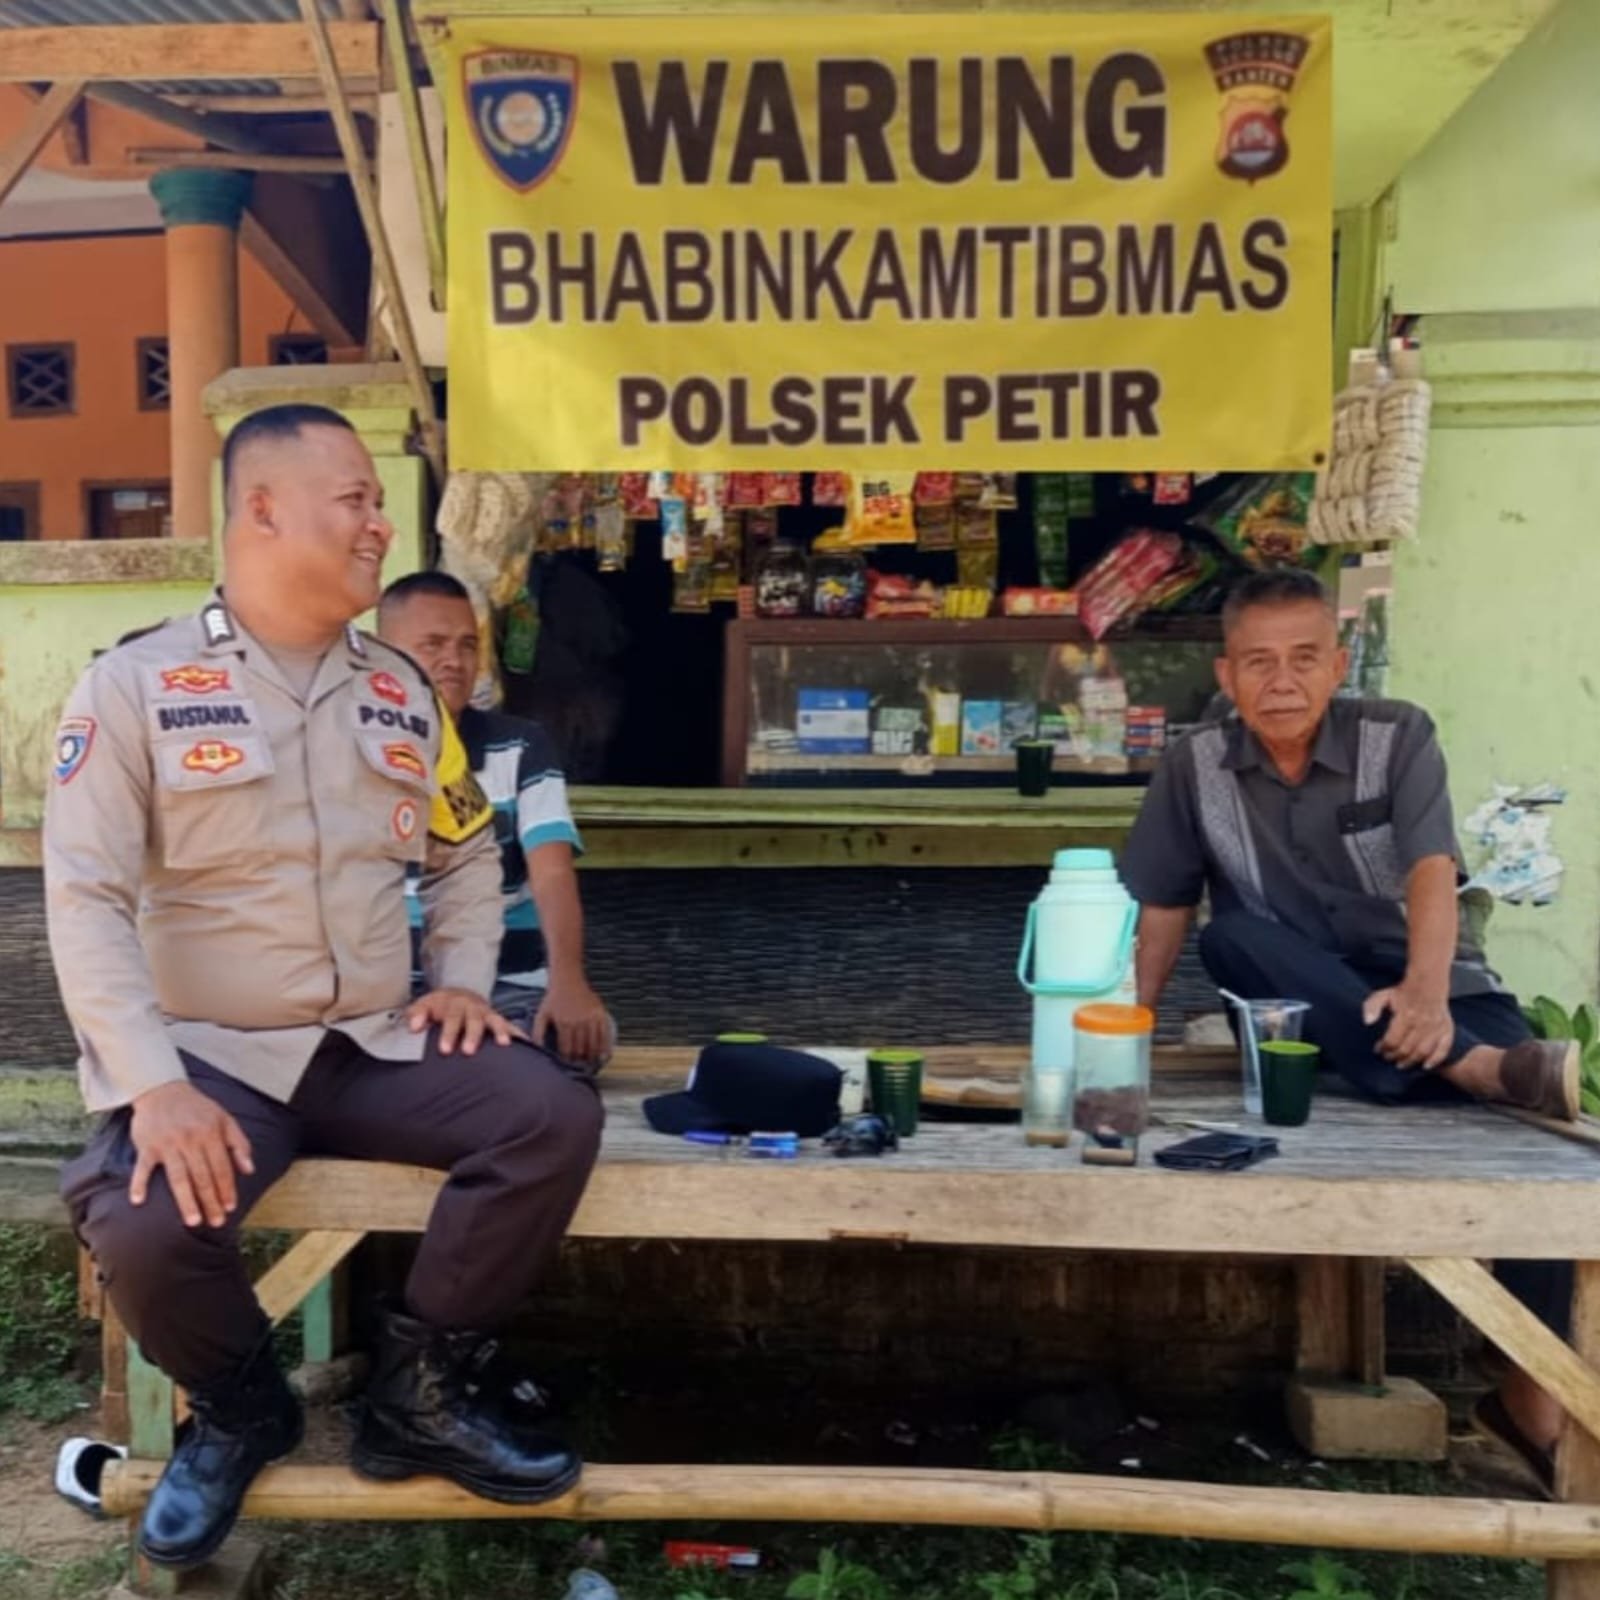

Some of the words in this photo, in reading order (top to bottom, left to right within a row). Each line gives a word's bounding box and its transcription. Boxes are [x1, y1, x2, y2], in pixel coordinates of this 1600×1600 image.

[610, 52, 1167, 186] WARUNG
[489, 219, 1290, 324] BHABINKAMTIBMAS
[619, 376, 920, 446] POLSEK
[944, 370, 1161, 442] PETIR
